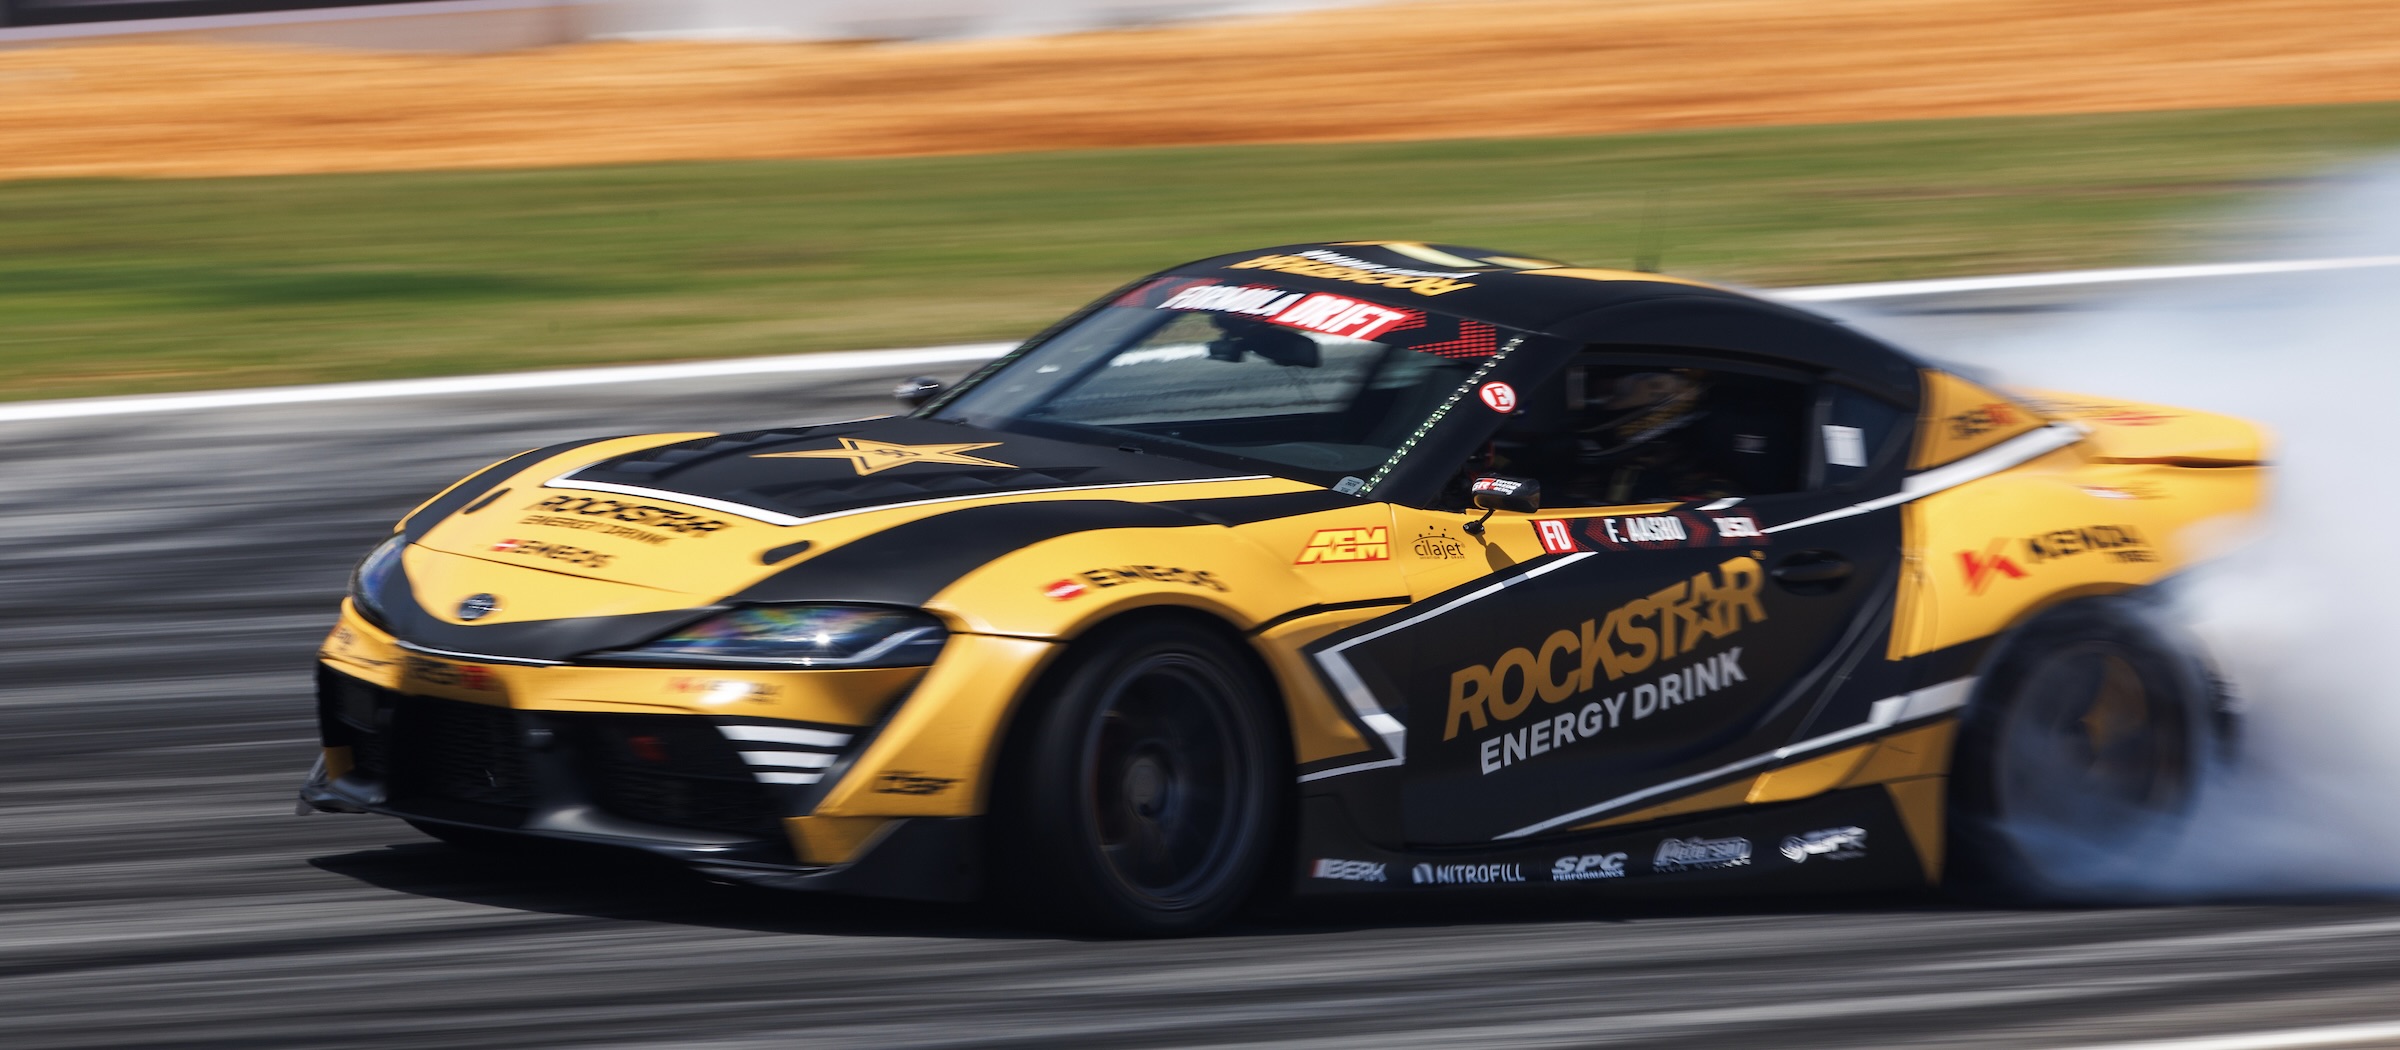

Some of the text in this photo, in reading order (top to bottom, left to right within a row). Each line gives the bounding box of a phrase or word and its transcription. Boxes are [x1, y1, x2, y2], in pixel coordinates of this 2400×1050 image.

[1155, 285, 1405, 339] FORMULA DRIFT
[1487, 386, 1511, 407] E
[521, 495, 733, 538] ROCKSTAR
[1296, 526, 1390, 564] AEM
[1539, 520, 1572, 551] FD
[1603, 518, 1629, 543] F.
[1414, 540, 1464, 560] cilajet
[1076, 565, 1230, 593] ENEOS
[1443, 556, 1768, 742] ROCKSTAR
[1480, 647, 1747, 775] ENERGY DRINK
[1436, 863, 1526, 883] NITROFILL
[1551, 852, 1629, 874] SPC
[1553, 869, 1626, 881] PERFORMANCE
